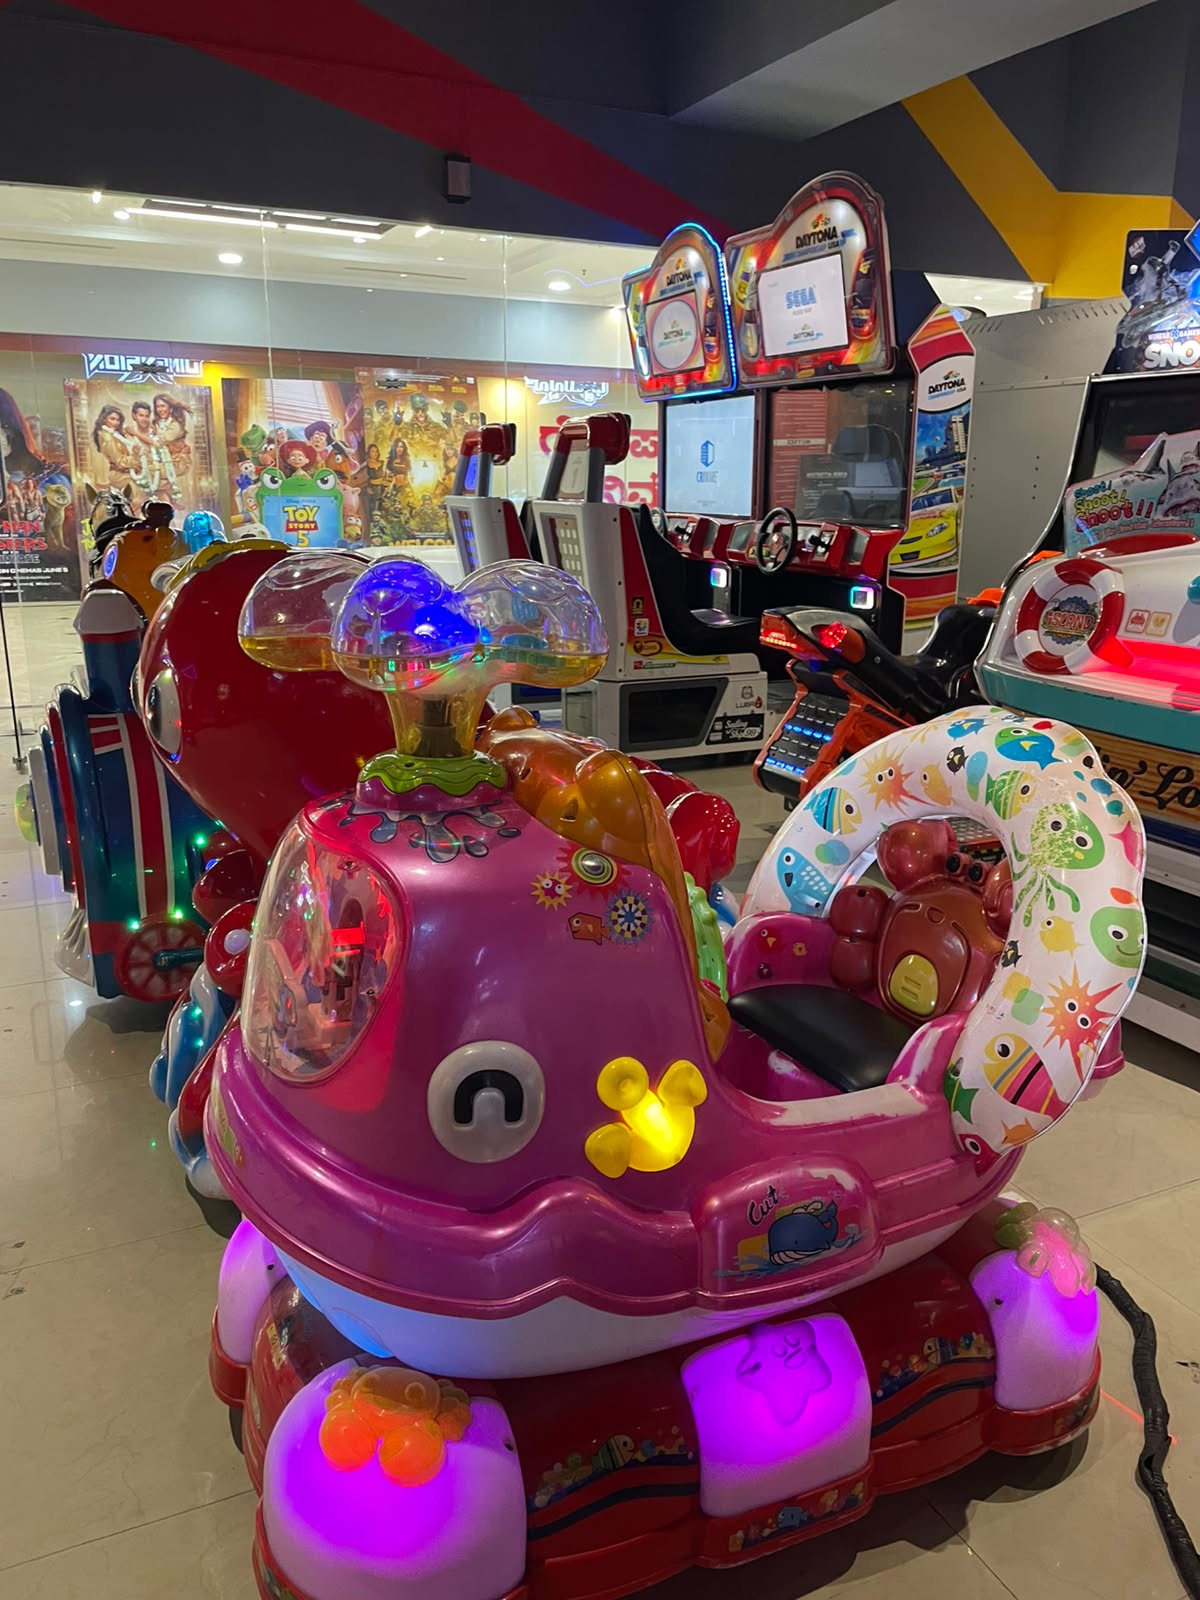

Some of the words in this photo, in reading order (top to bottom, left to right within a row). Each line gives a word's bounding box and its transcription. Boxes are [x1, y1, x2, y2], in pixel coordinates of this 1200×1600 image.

[795, 226, 838, 249] DAYTONA
[785, 287, 817, 309] SEGA
[1143, 340, 1200, 369] SNO
[928, 378, 966, 395] DAYTONA
[1074, 480, 1112, 499] Shoot!
[1074, 489, 1127, 510] Shoot!
[283, 505, 320, 522] TOY
[287, 522, 316, 530] STORY
[297, 530, 310, 547] 5
